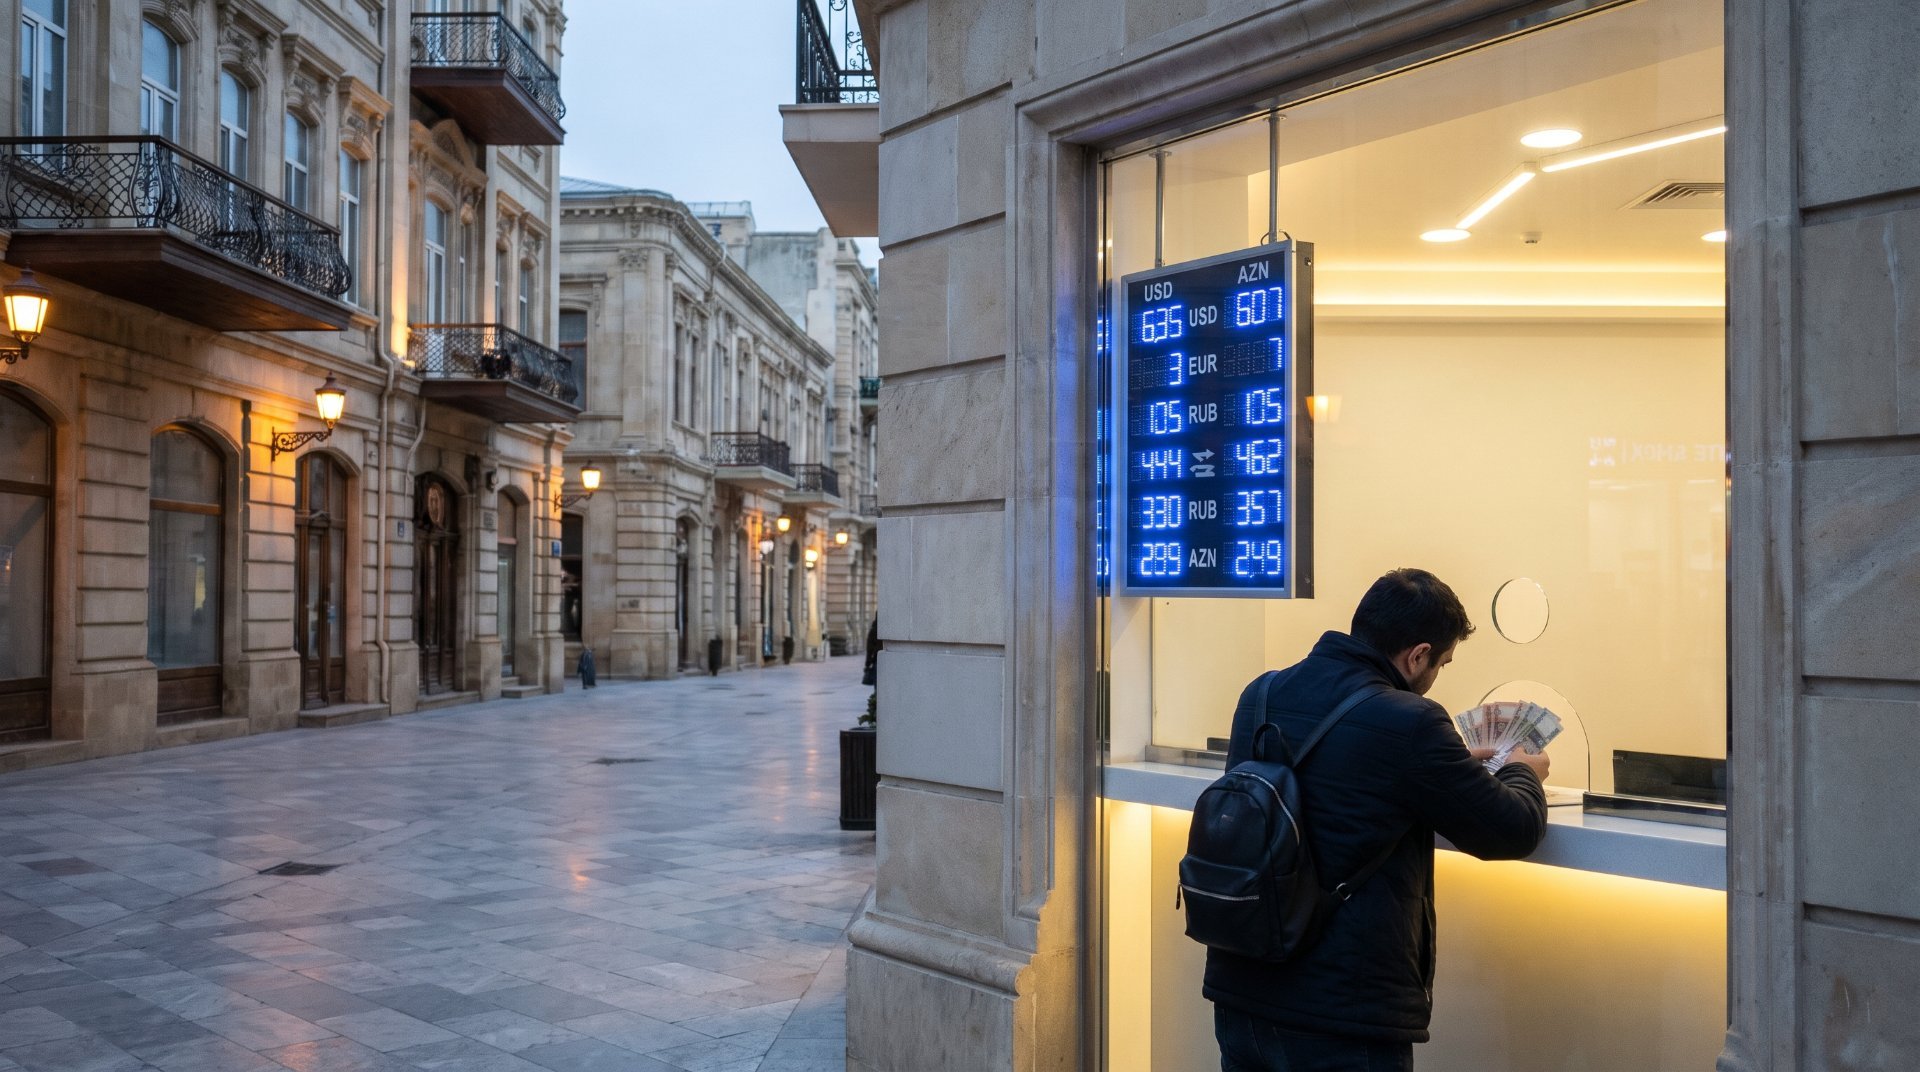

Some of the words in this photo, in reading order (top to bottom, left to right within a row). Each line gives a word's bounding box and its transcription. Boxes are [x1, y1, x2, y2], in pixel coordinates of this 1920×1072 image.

[1144, 281, 1173, 302] USD
[1237, 261, 1269, 284] AZN
[1189, 305, 1218, 327] USD
[1236, 286, 1282, 326] 607
[1169, 352, 1182, 385] 3
[1188, 354, 1218, 376] EUR
[1269, 337, 1282, 368] 7
[1150, 400, 1182, 434] 105
[1188, 403, 1218, 424] RUB
[1246, 387, 1282, 424] 105
[1142, 449, 1182, 480] 444
[1236, 438, 1282, 475] 462
[1142, 495, 1182, 528] 330
[1188, 500, 1218, 520] RUB
[1237, 489, 1282, 525] 357
[1188, 548, 1217, 568] AZN
